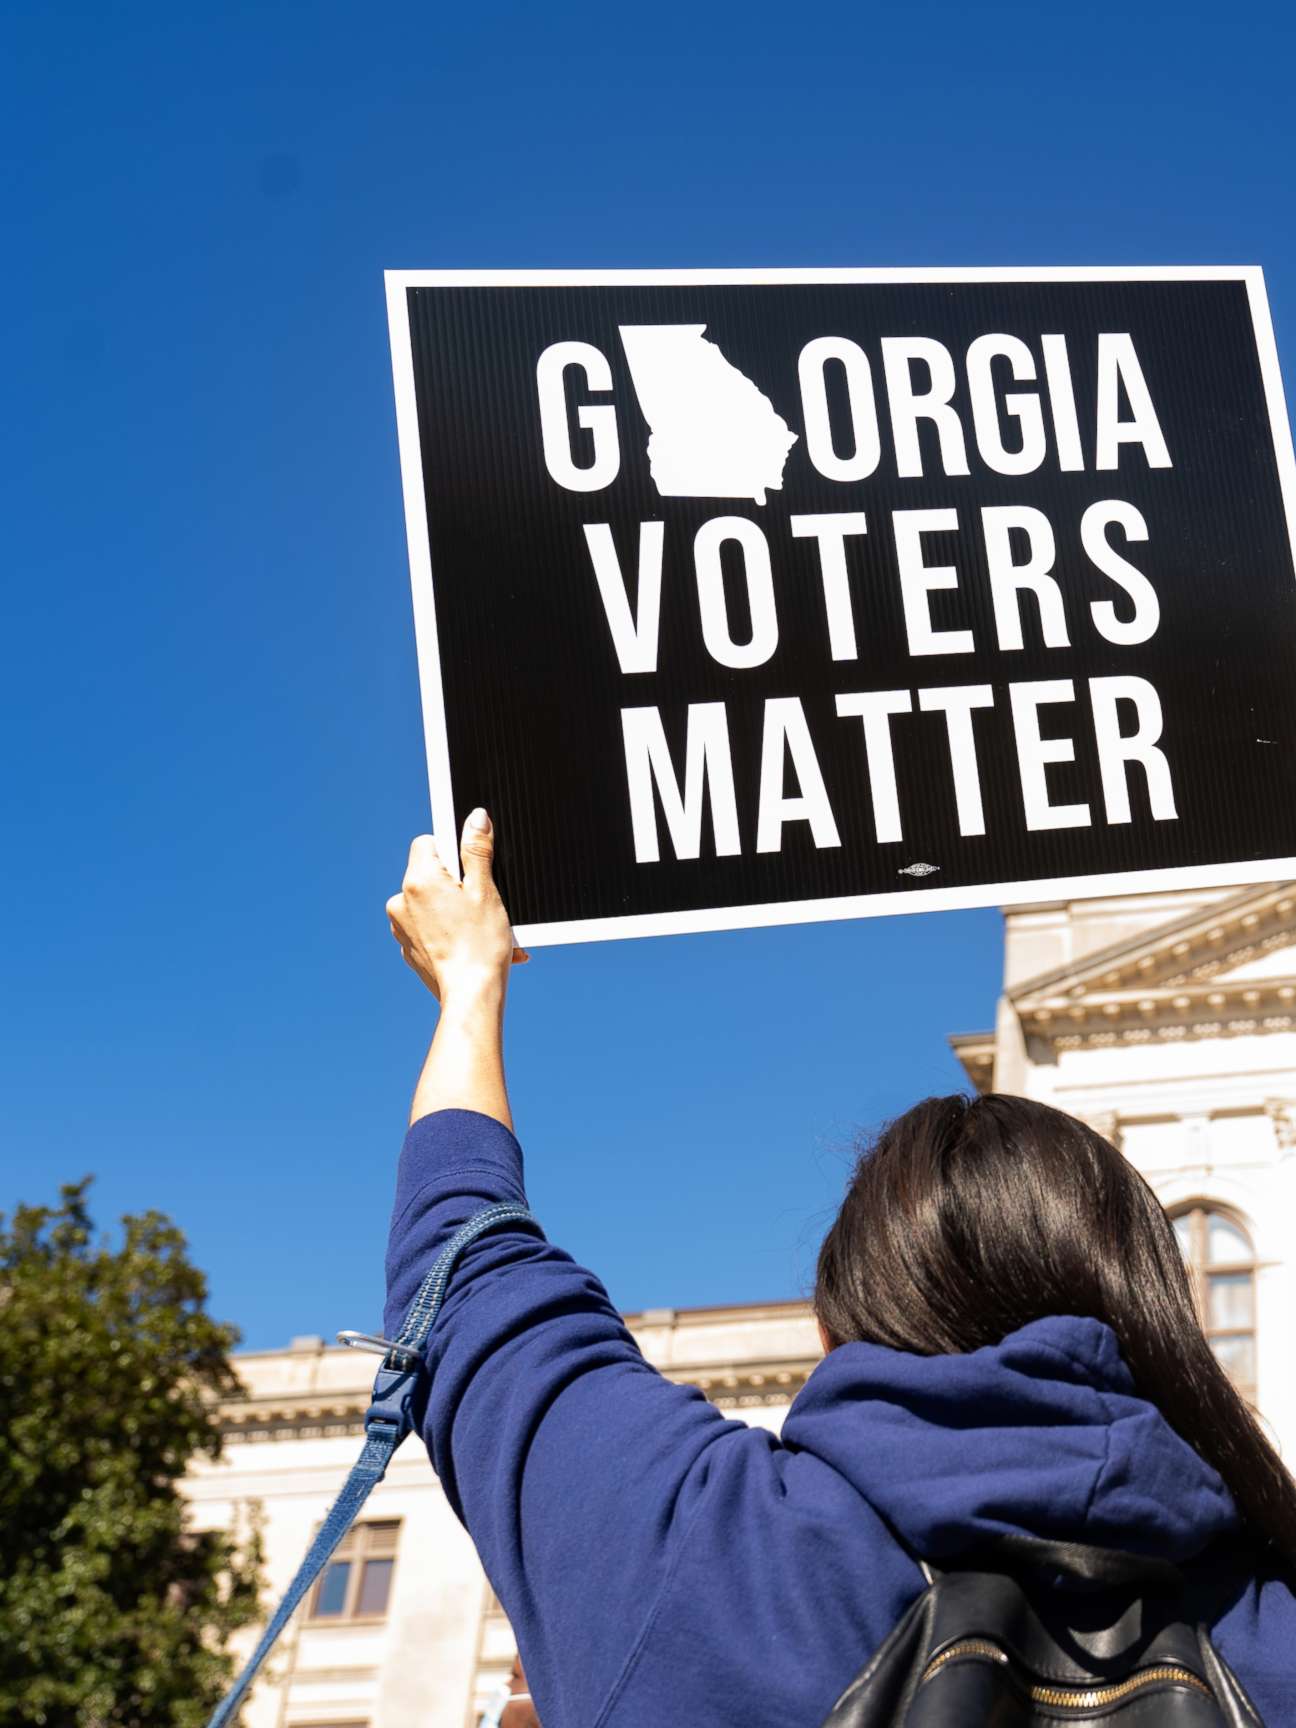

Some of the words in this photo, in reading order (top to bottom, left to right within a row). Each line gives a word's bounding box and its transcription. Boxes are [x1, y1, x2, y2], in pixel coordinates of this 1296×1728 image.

[536, 331, 1174, 494] GORGIA
[582, 499, 1161, 674] VOTERS
[620, 675, 1179, 864] MATTER
